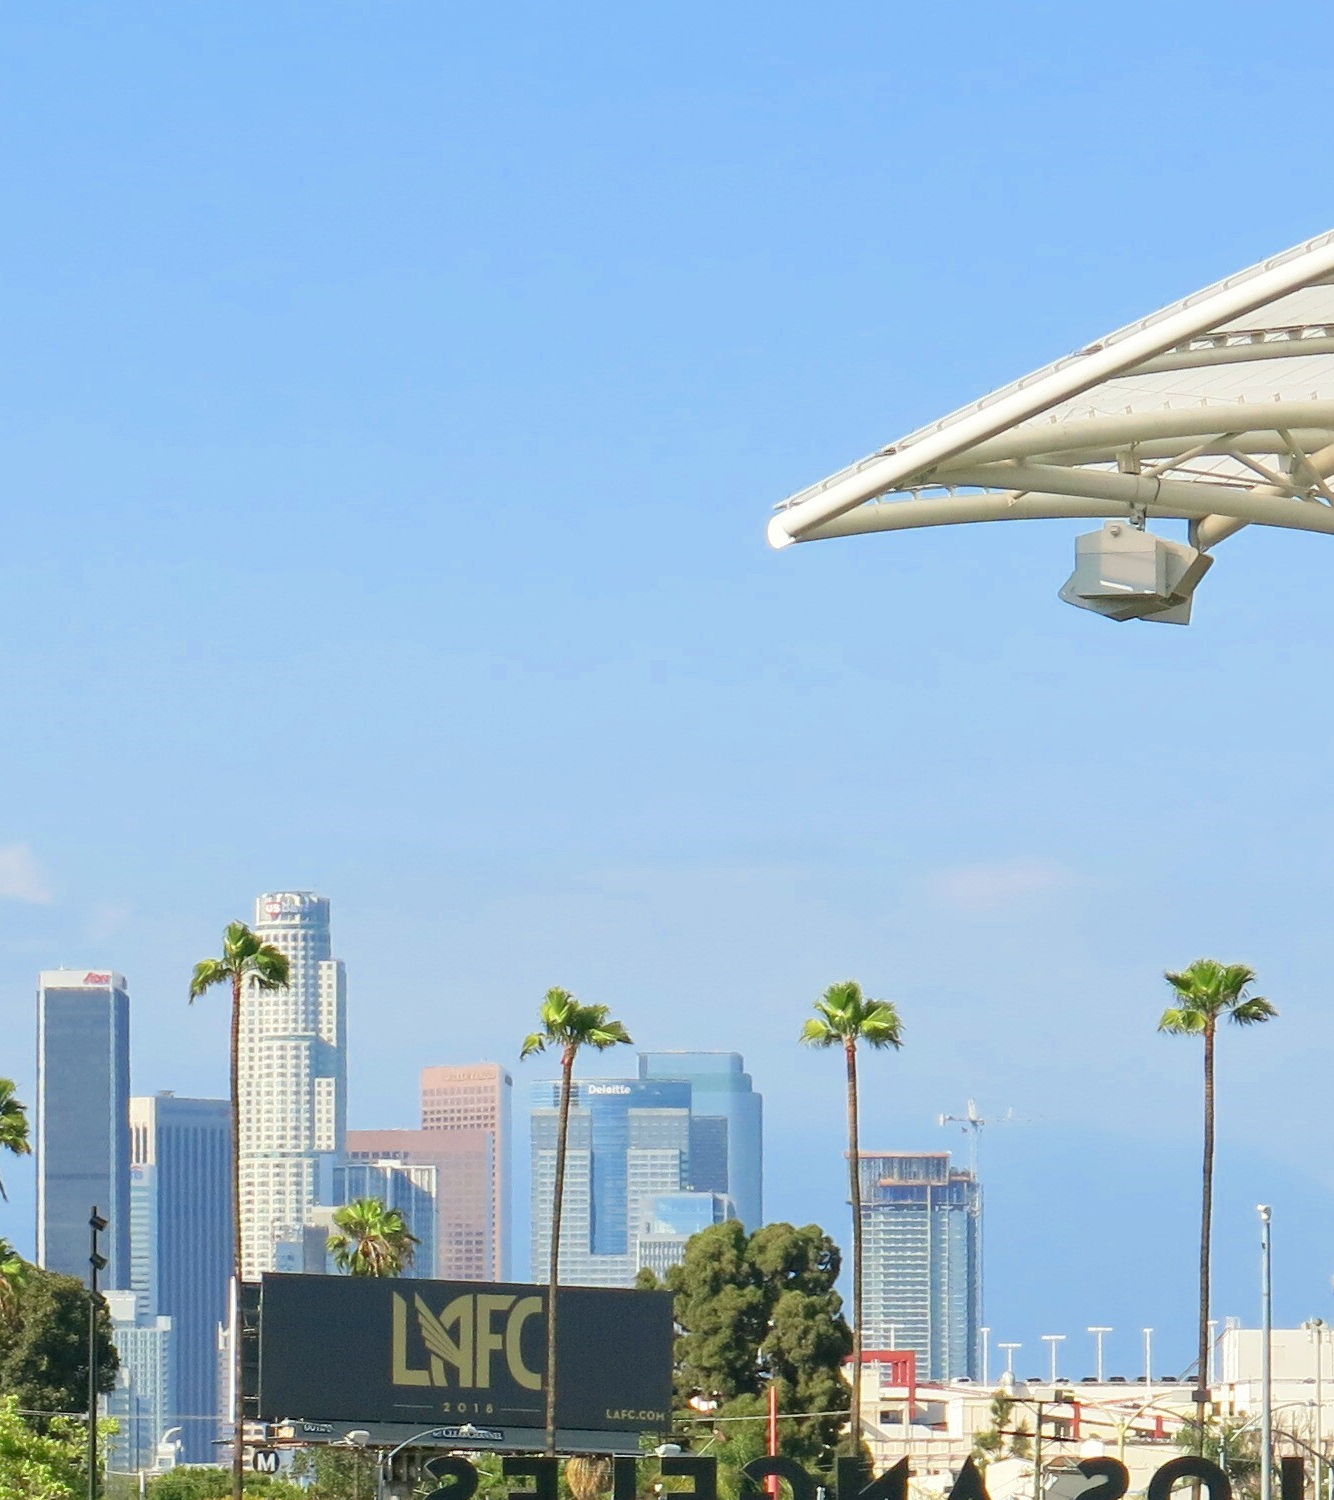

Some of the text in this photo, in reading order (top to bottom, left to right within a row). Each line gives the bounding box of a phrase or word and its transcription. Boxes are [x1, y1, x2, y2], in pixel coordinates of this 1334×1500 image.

[588, 1084, 631, 1095] Deloitte
[392, 1290, 543, 1391] LAFC
[443, 1402, 494, 1414] 2018
[606, 1408, 665, 1422] LAFC.COM
[257, 1452, 276, 1472] M
